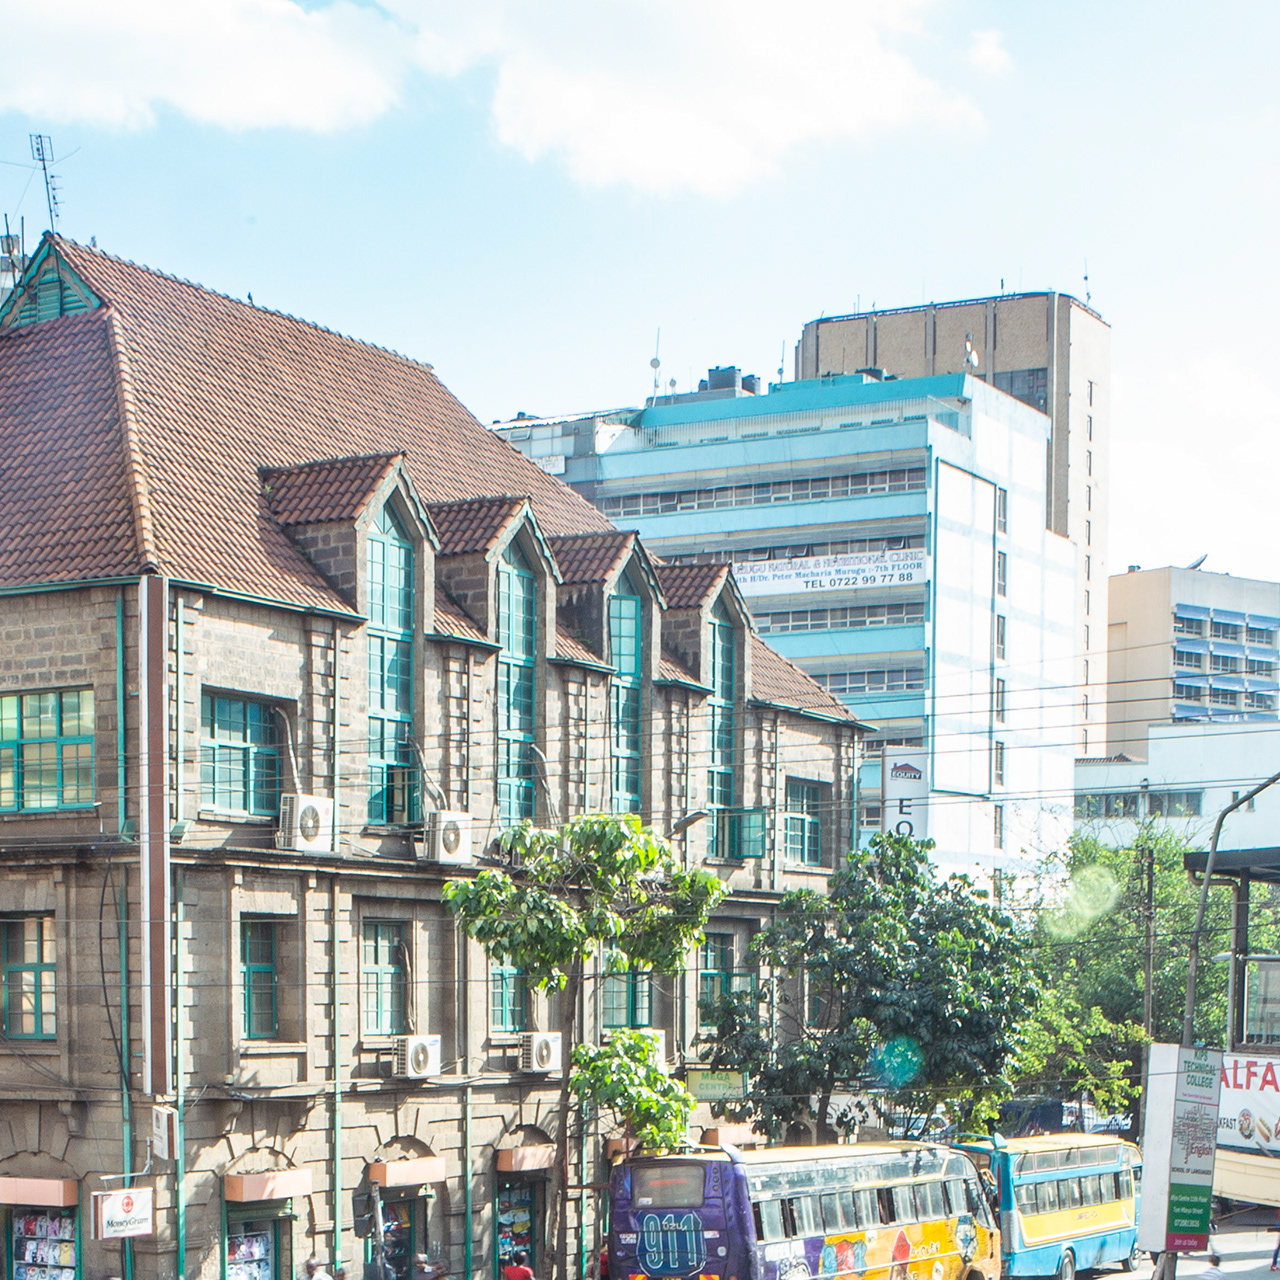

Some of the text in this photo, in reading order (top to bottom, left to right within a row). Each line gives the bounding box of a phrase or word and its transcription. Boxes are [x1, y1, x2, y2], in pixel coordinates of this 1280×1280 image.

[889, 550, 925, 562] CLINIC
[772, 572, 793, 580] Peter
[795, 568, 832, 578] Macharia
[835, 565, 866, 576] Murugu
[891, 562, 923, 571] FLOOR
[803, 572, 914, 590] TEL 0722 99 77 88
[892, 771, 920, 779] EQUITY
[1184, 1060, 1217, 1076] TECHNICAL
[701, 1072, 731, 1080] MEGA
[1186, 1074, 1213, 1088] COLLEGE
[1191, 1144, 1212, 1158] English
[106, 1217, 148, 1229] MoneyGram
[643, 1214, 697, 1269] 911
